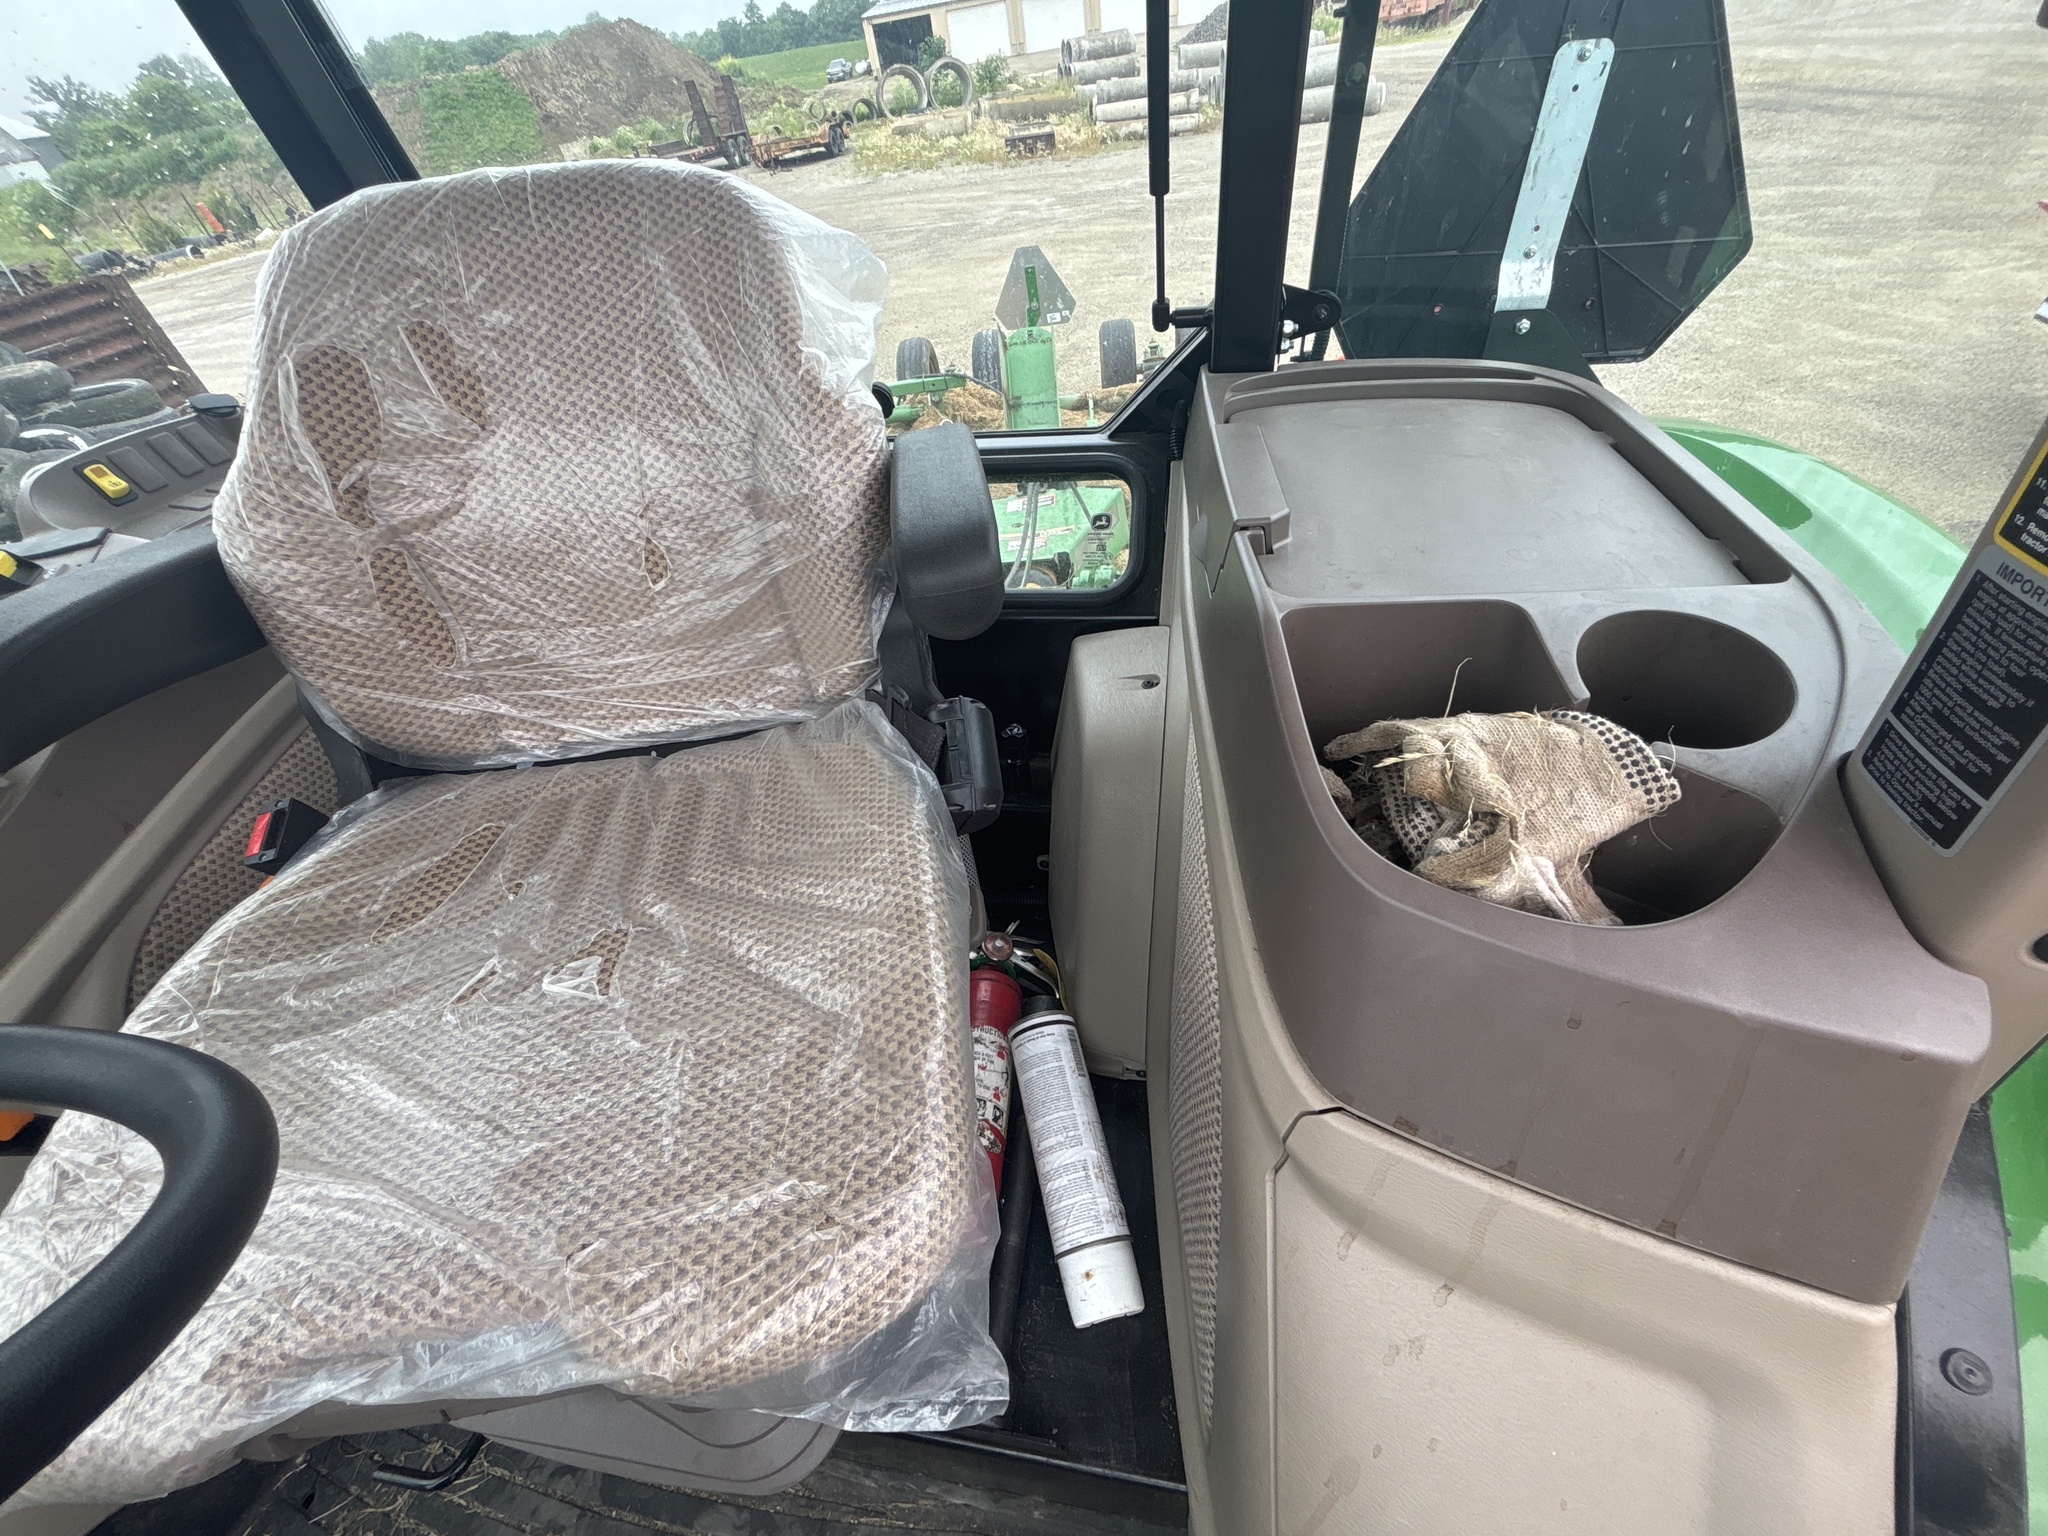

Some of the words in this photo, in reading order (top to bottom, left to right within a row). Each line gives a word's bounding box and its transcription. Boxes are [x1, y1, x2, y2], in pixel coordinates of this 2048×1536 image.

[2014, 513, 2024, 526] 12.
[2020, 532, 2048, 554] tractor
[1970, 598, 1985, 611] rpm
[1983, 606, 1997, 620] (no
[1994, 615, 2015, 633] load)
[2013, 628, 2026, 640] for
[2026, 637, 2042, 650] one
[1975, 589, 1999, 609] engine
[1996, 592, 2026, 615] starting
[1940, 646, 1962, 665] stalled
[1960, 662, 1978, 679] while
[1976, 676, 2007, 702] working
[1946, 637, 1962, 652] Start
[1959, 650, 1983, 672] engine
[1980, 666, 2027, 704] immediately
[1950, 630, 1976, 652] minutes
[1973, 649, 1988, 663] (no
[1986, 658, 2008, 678] load).
[1955, 622, 1978, 642] engine
[1976, 638, 1987, 649] for
[1986, 646, 2000, 659] two
[2008, 662, 2026, 678] four
[1960, 614, 1980, 631] below
[1978, 628, 2008, 653] freezing
[2027, 664, 2048, 684] oper
[2000, 631, 2047, 667] temperature
[1927, 668, 1947, 688] Before
[1944, 685, 1974, 713] stopping
[1973, 708, 1993, 727] warm
[1992, 723, 2022, 750] engine,
[1935, 654, 1959, 675] provide
[1956, 672, 2001, 711] turbocharger
[1909, 697, 1923, 712] After
[1920, 710, 1952, 741] prolonged
[1951, 737, 1965, 750] idle
[1963, 747, 1994, 776] periods,
[1922, 676, 1934, 688] idle
[1932, 686, 1954, 707] several
[1953, 704, 1981, 729] minutes
[1980, 726, 2003, 746] under
[1930, 696, 1943, 710] rpm
[1949, 712, 1965, 728] cool
[1964, 723, 2011, 766] turbocharger
[1883, 758, 1896, 773] mph
[1888, 730, 1903, 746] Drive
[1901, 743, 1915, 758] train
[1914, 756, 1926, 769] and
[1925, 767, 1937, 780] tire
[1936, 777, 1948, 789] life
[1947, 787, 1960, 801] can
[1899, 712, 1921, 735] starting
[1919, 731, 1957, 768] instructions.
[1943, 741, 1967, 765] Manual
[1967, 762, 1979, 774] for
[1884, 736, 1908, 762] extended
[1914, 767, 1941, 795] avoiding
[1940, 792, 1956, 809] high
[1884, 782, 1903, 804] towing
[1899, 764, 1915, 782] travel
[1914, 779, 1937, 803] speeds
[1936, 799, 1957, 821] below
[1918, 804, 1943, 830] manual
